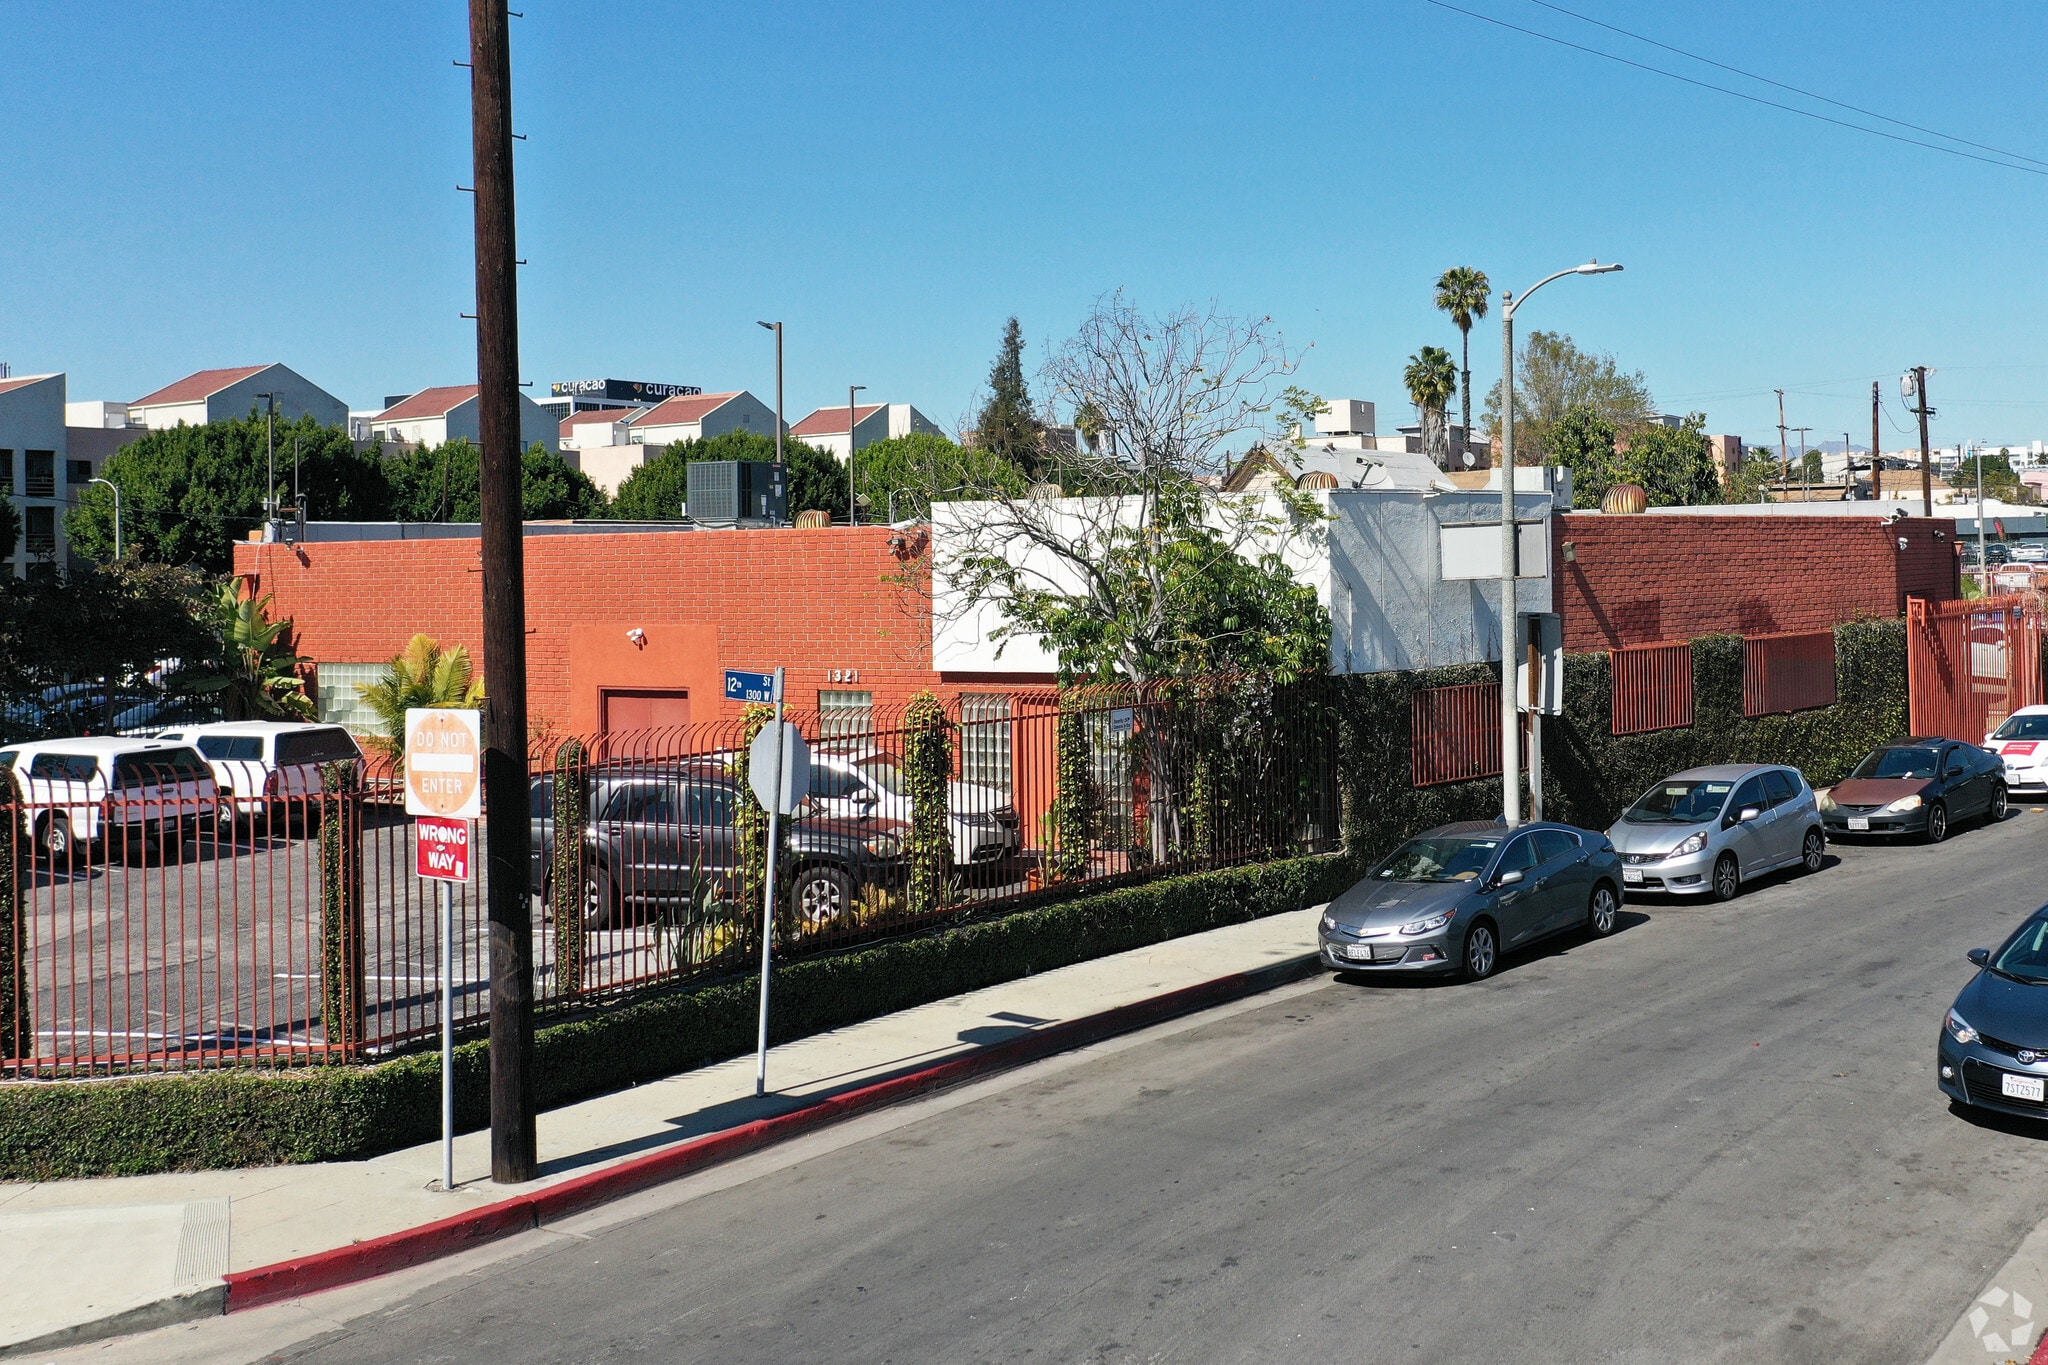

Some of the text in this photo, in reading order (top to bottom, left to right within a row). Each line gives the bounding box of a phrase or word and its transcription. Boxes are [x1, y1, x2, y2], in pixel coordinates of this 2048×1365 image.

[561, 379, 606, 392] curacao
[646, 383, 701, 396] curacao
[763, 676, 771, 687] St
[827, 670, 859, 682] 1321
[746, 689, 770, 701] 1300 W
[417, 731, 468, 748] DO NOT
[421, 778, 463, 795] ENTER
[418, 824, 466, 845] WRONG
[428, 851, 456, 871] WAY
[2005, 1082, 2041, 1097] 7ST2577
